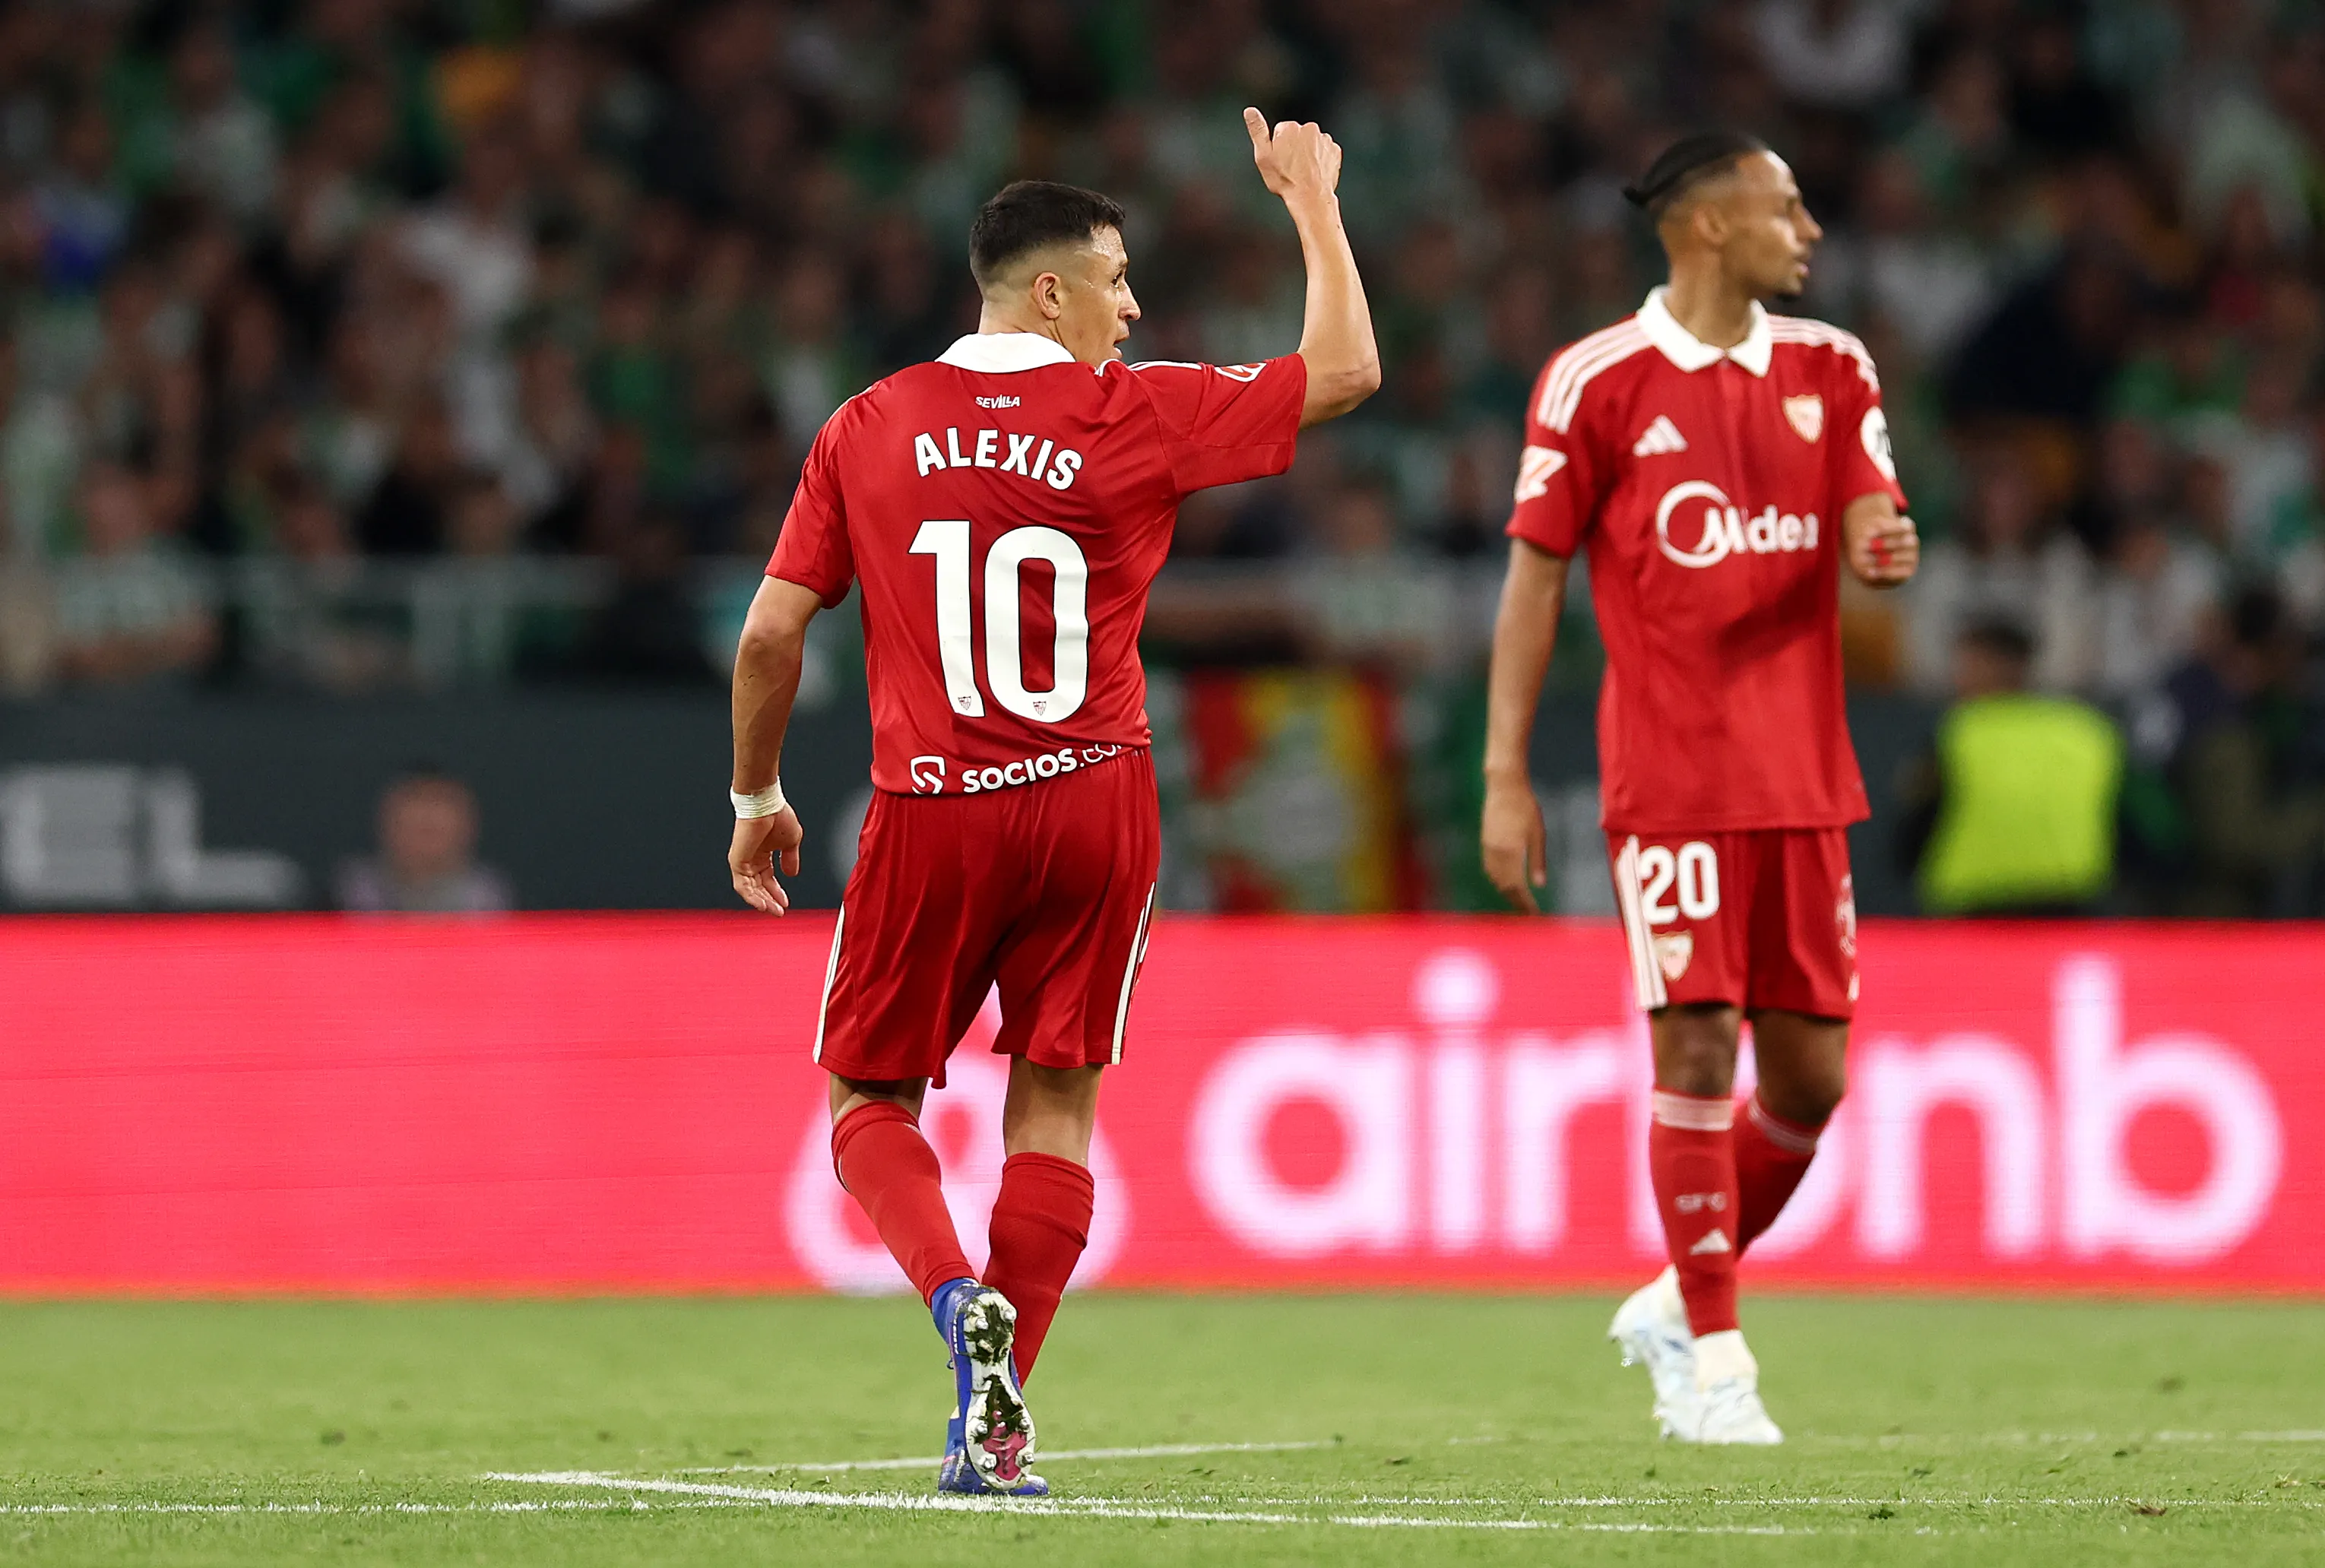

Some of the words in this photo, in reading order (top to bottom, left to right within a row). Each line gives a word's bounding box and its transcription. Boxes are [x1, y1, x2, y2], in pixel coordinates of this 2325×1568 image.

[975, 394, 1021, 409] SEVILLA
[914, 426, 1083, 490] ALEXIS
[908, 520, 1089, 723] 10
[961, 743, 1122, 793] SOCIOS.CO
[1639, 841, 1720, 925] 20
